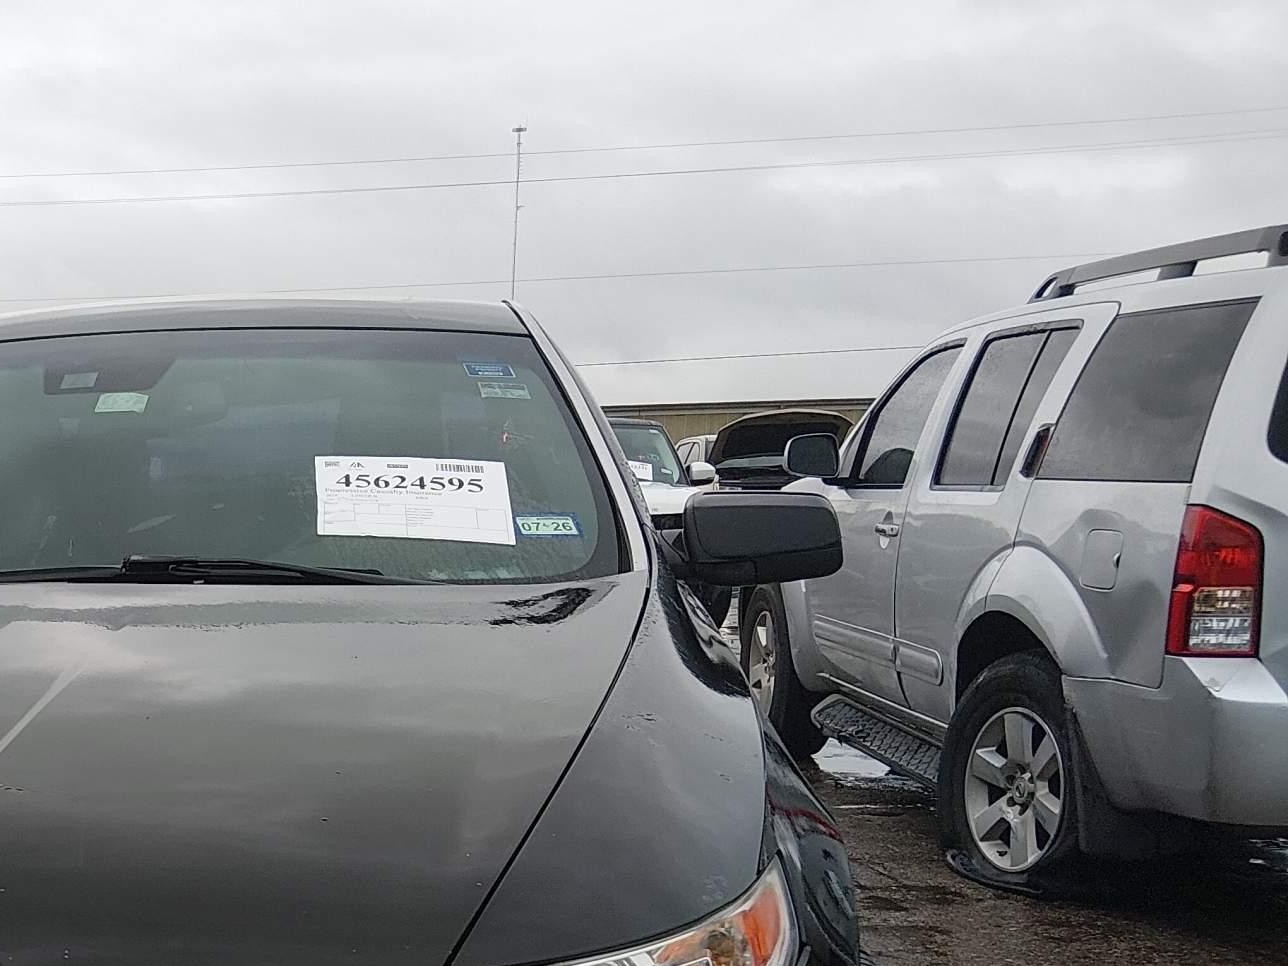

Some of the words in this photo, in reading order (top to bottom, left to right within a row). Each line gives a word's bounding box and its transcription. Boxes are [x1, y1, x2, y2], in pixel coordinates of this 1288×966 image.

[335, 473, 484, 494] 45624595
[520, 521, 541, 532] 07
[551, 521, 573, 532] 26
